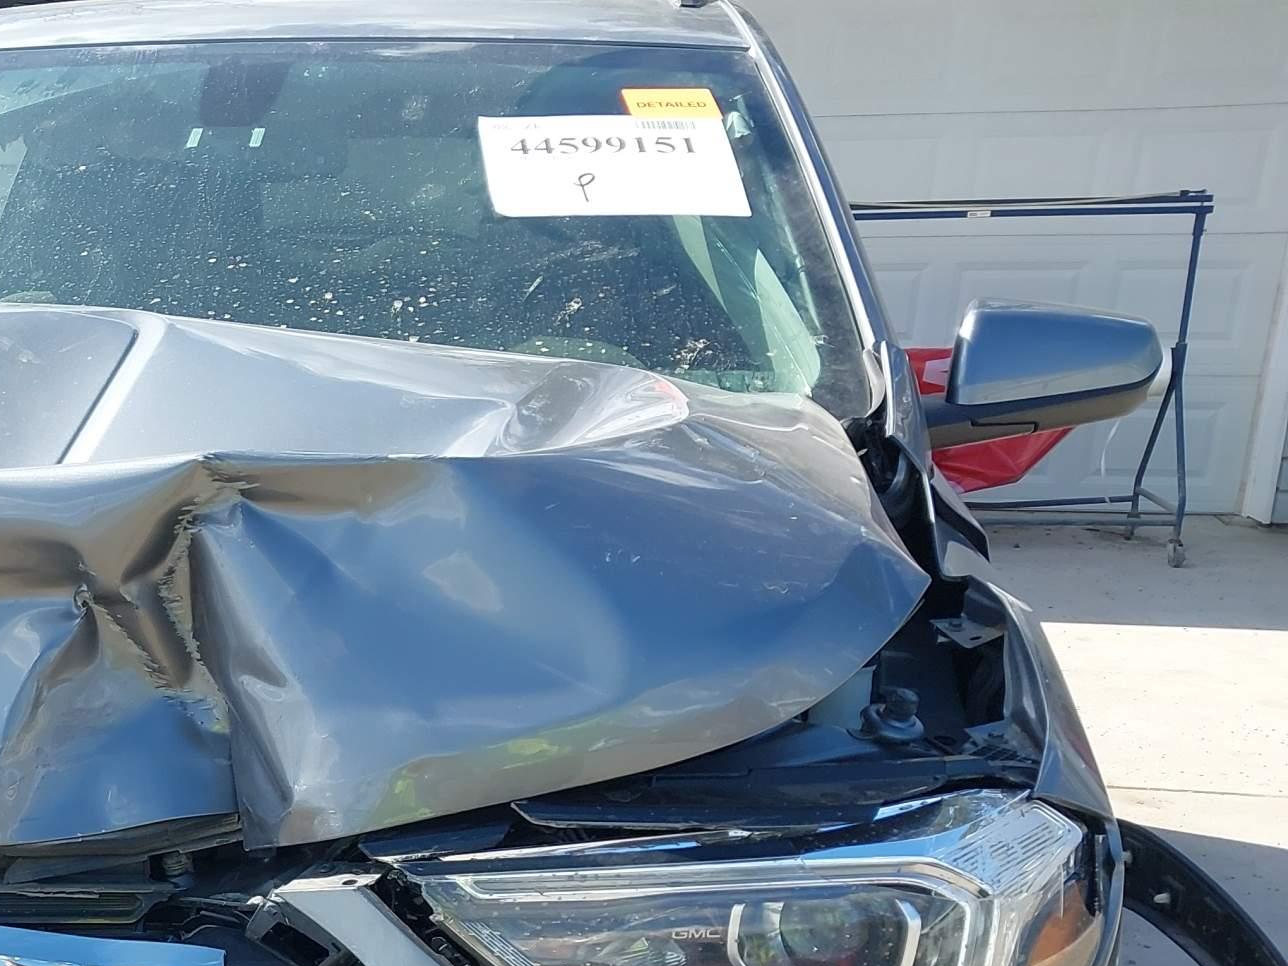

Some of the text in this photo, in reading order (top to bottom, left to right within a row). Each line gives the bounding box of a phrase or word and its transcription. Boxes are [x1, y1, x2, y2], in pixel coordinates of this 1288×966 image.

[636, 101, 708, 109] DETAILED
[510, 136, 697, 155] 44599151
[672, 929, 721, 939] GMC
